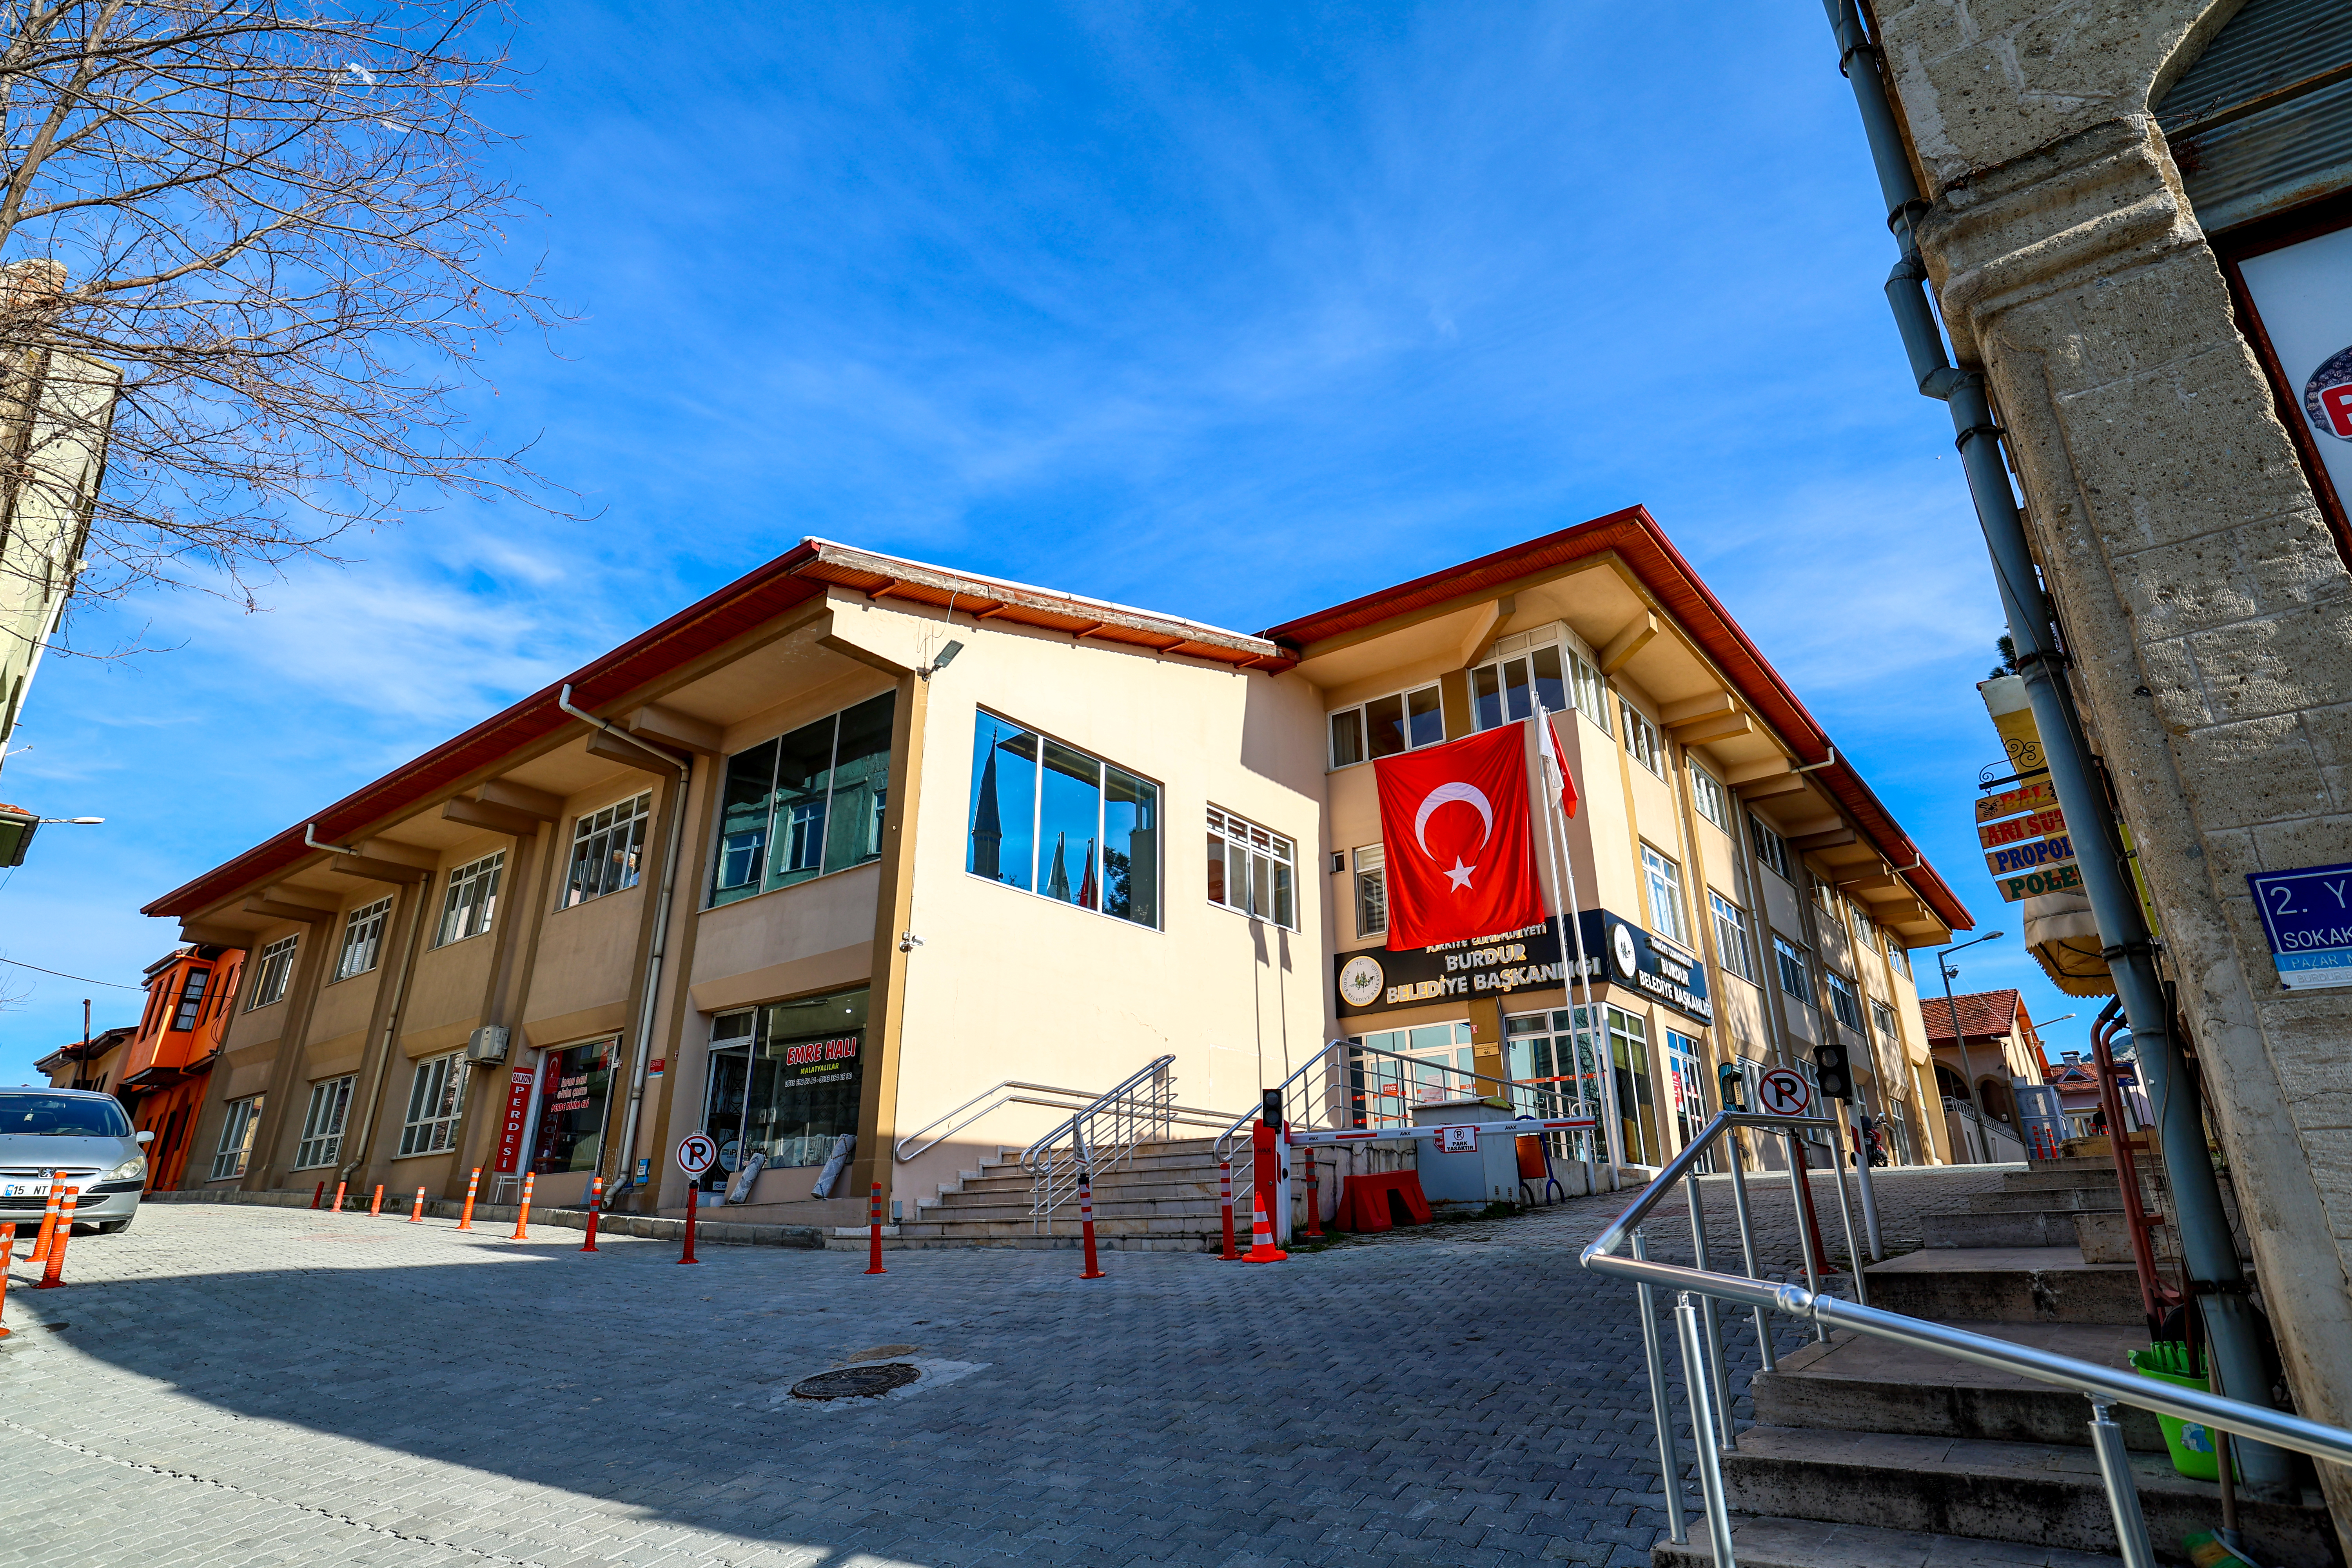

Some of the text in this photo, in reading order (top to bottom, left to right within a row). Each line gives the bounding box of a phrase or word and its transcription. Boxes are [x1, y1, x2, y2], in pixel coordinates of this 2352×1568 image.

[2000, 786, 2049, 811] BAL
[1987, 820, 2025, 845] ARI
[1995, 837, 2075, 872] PROPOL
[2007, 864, 2083, 899] POLE
[2270, 887, 2308, 915] 2.
[2283, 926, 2352, 949] SOKAK
[1445, 943, 1527, 972] BURDUR
[1650, 936, 1668, 955] TÜRKİYE
[1668, 947, 1694, 969] CUMHURİYETİ
[2291, 955, 2339, 969] PAZAR
[1387, 953, 1602, 1004] BELEDİYE BAŞKANLIĞI
[1660, 957, 1690, 987] BURDUR
[2296, 971, 2343, 983] BURDUR
[1347, 993, 1371, 1002] BELEDİYE
[1638, 969, 1713, 1019] BELEDİYE BAŞKANLIĞI
[786, 1037, 857, 1066] EMRE HALI
[512, 1073, 532, 1083] BALKON
[800, 1063, 839, 1074] MALATYALILAR
[819, 1075, 830, 1083] 0533
[830, 1074, 839, 1082] 364
[550, 1097, 590, 1112] PERDE DİKİM EVİ
[502, 1086, 525, 1168] PERDESİ
[14, 1186, 48, 1195] 15 NT
